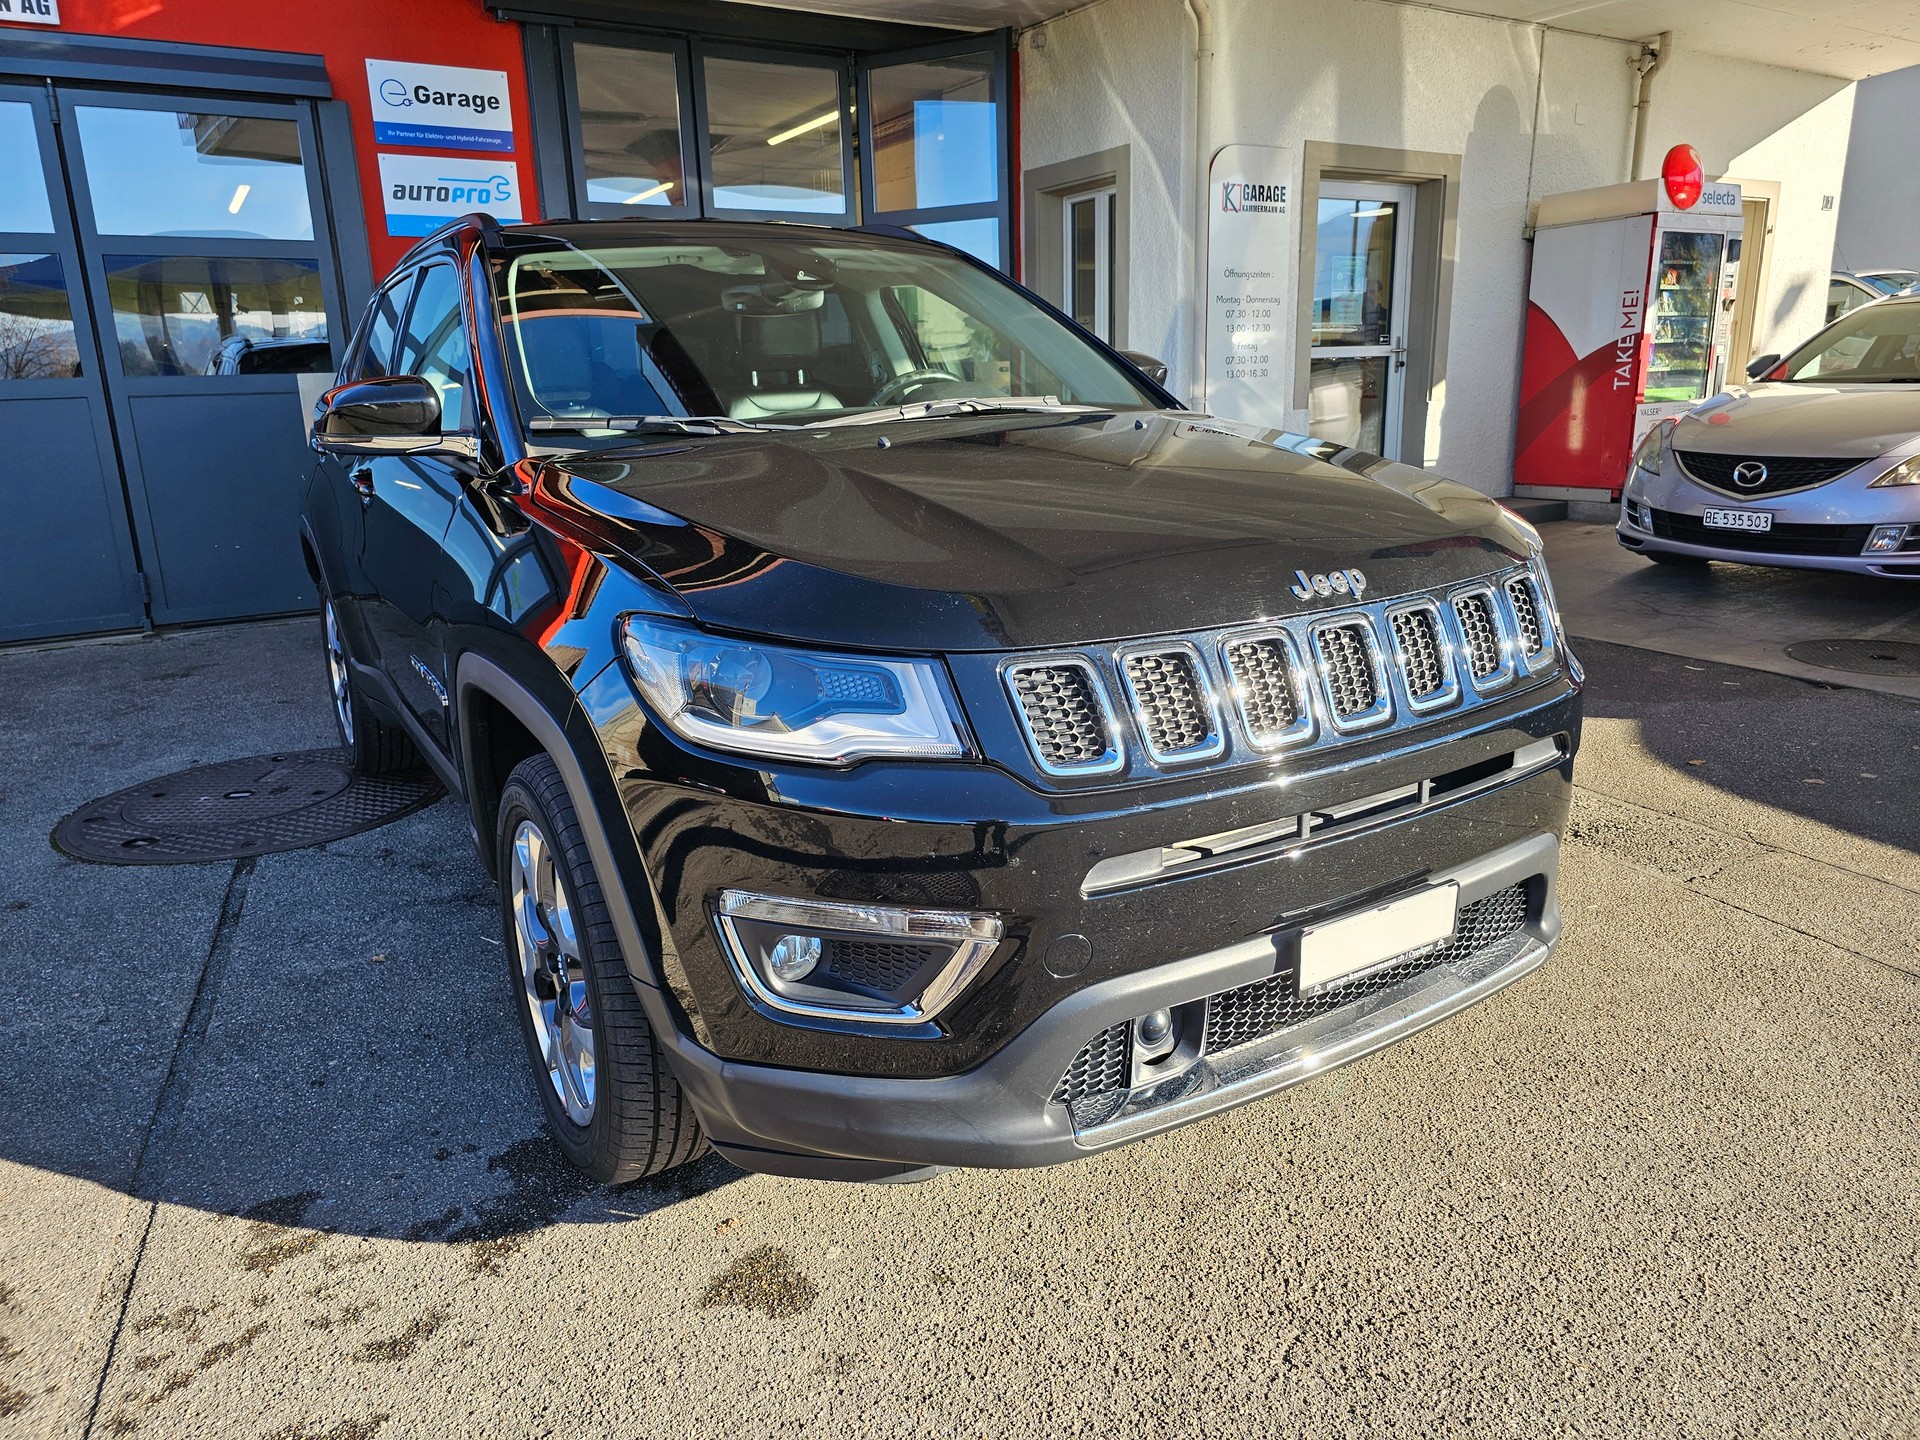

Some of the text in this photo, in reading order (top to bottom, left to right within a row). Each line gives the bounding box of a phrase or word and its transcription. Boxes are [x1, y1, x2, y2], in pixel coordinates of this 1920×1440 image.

[396, 130, 416, 138] Partner
[1242, 184, 1286, 203] GARAGE
[1701, 190, 1736, 206] selecta
[1242, 204, 1285, 214] KAMMERMANN AG
[1223, 266, 1271, 281] Öffnungszeiten
[1216, 295, 1241, 307] Montag
[1245, 295, 1281, 306] Donnerstag
[1225, 309, 1247, 319] 07.30
[1252, 309, 1271, 318] 12.00
[1226, 324, 1246, 333] 13.00
[1252, 323, 1271, 332] 17.30
[1613, 289, 1640, 391] TAKE ME!
[1289, 568, 1367, 602] Jeep
